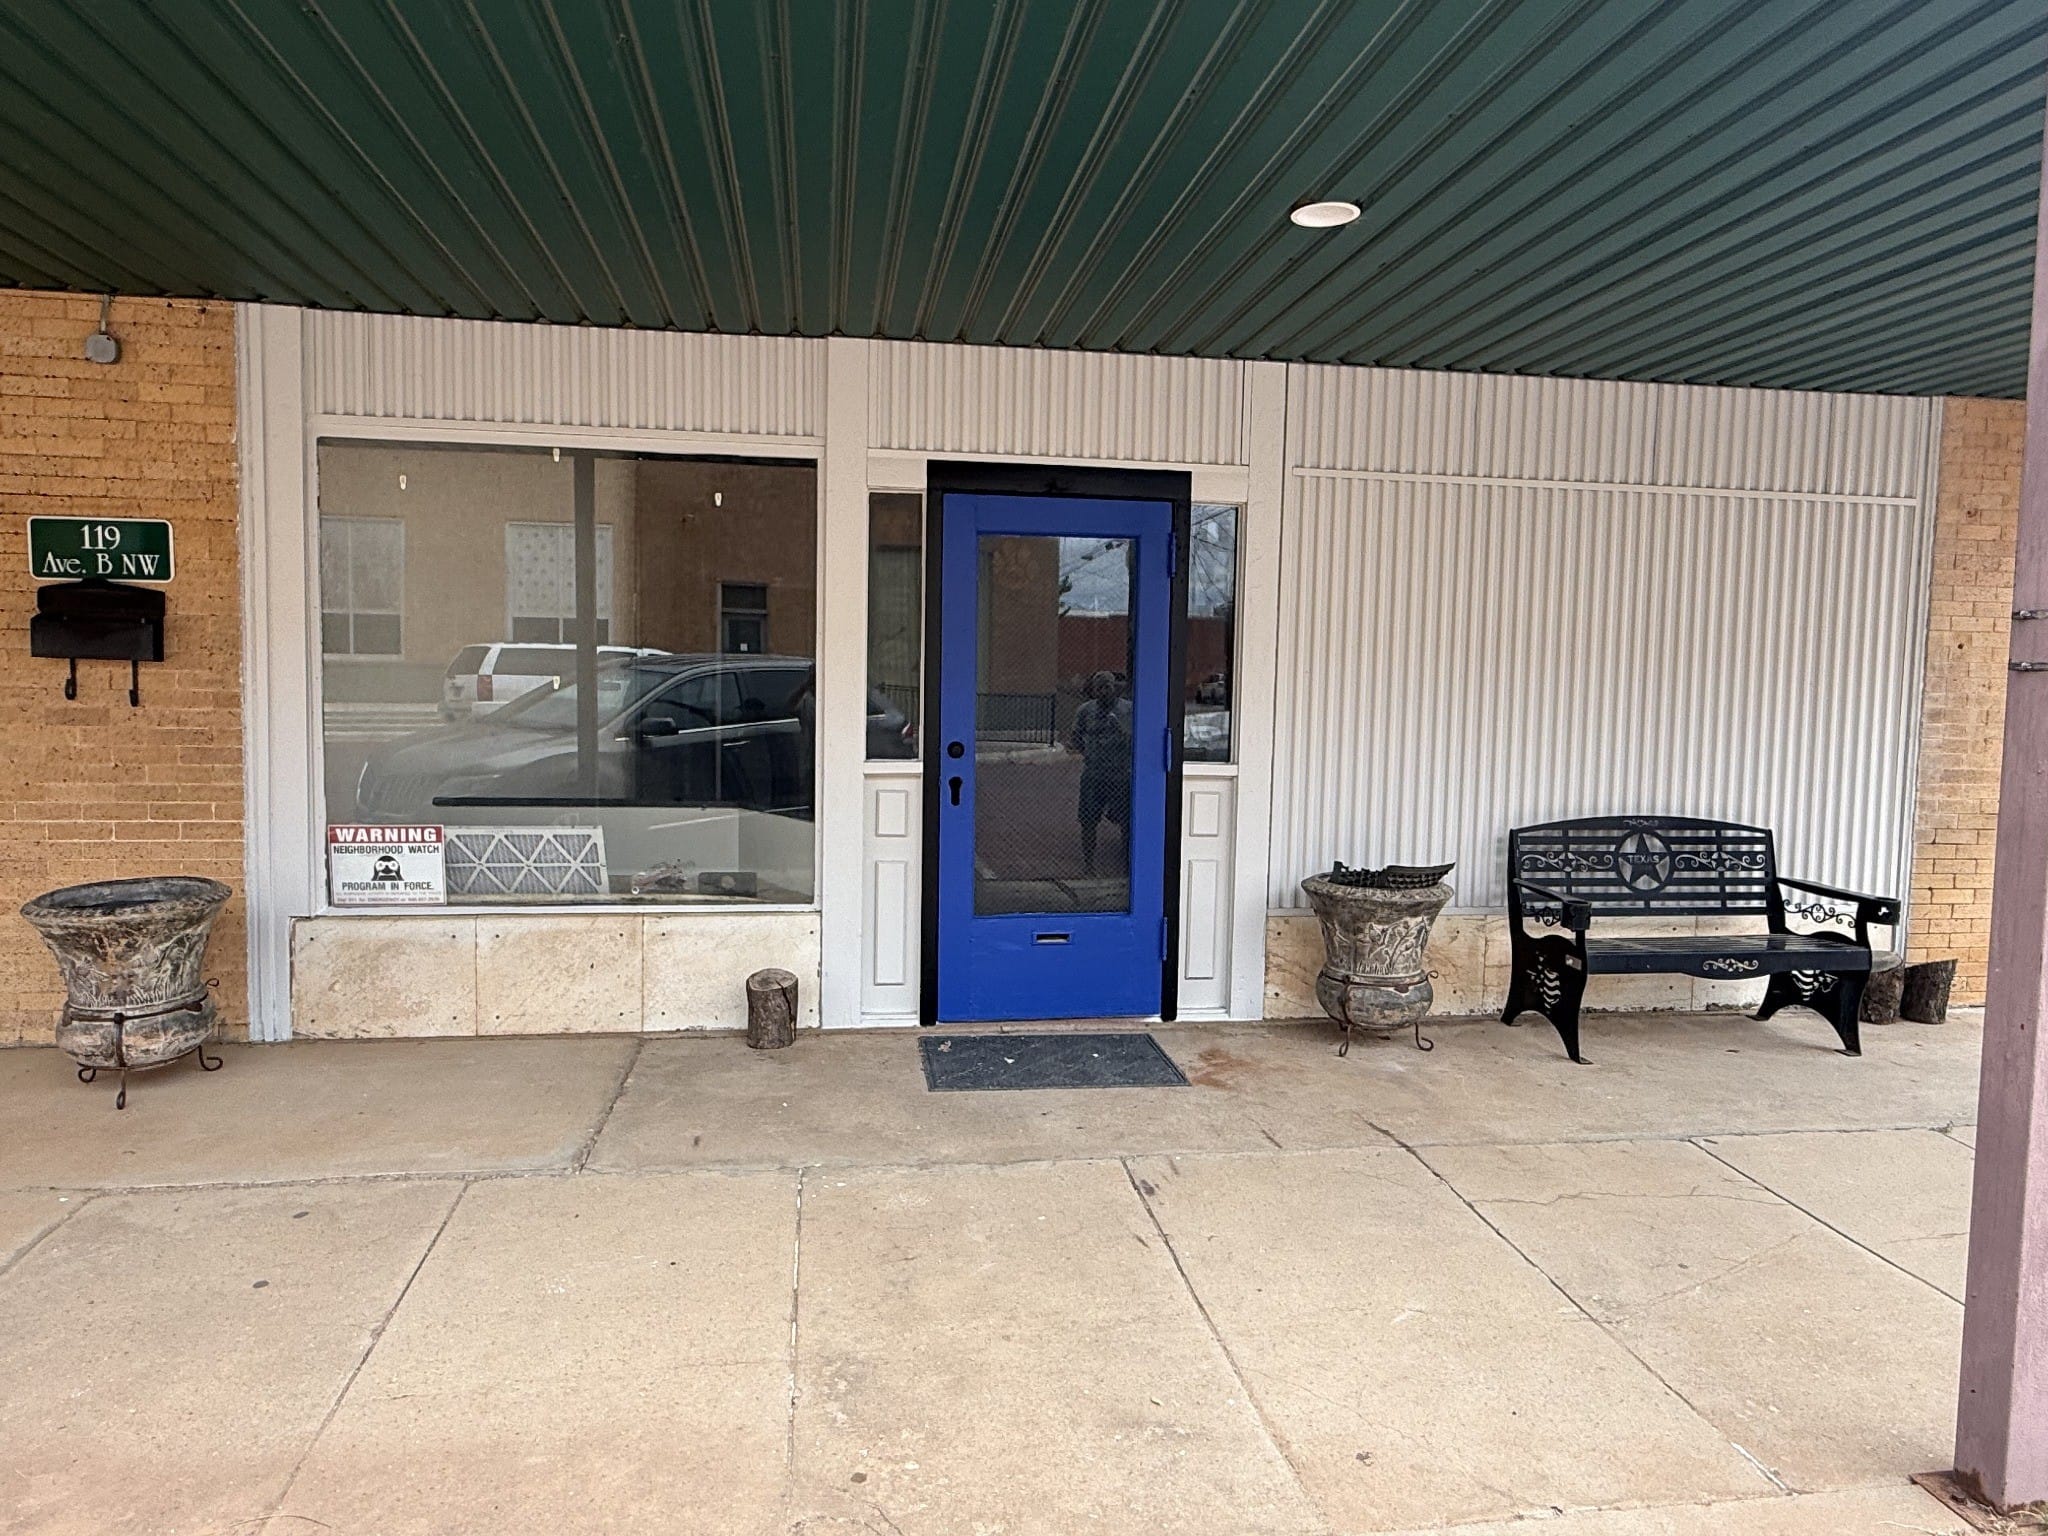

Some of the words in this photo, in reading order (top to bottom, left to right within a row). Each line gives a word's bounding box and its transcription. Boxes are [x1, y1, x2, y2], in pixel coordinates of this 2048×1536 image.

[80, 524, 121, 550] 119
[42, 551, 86, 574] Ave.
[96, 553, 113, 574] B
[121, 554, 160, 576] NW
[335, 828, 437, 842] WARNING
[333, 845, 404, 854] NEIGHBORHOOD
[408, 845, 440, 854] WATCH
[1627, 854, 1660, 864] TEXAS
[342, 882, 386, 891] PROGRAM
[390, 882, 399, 891] IN
